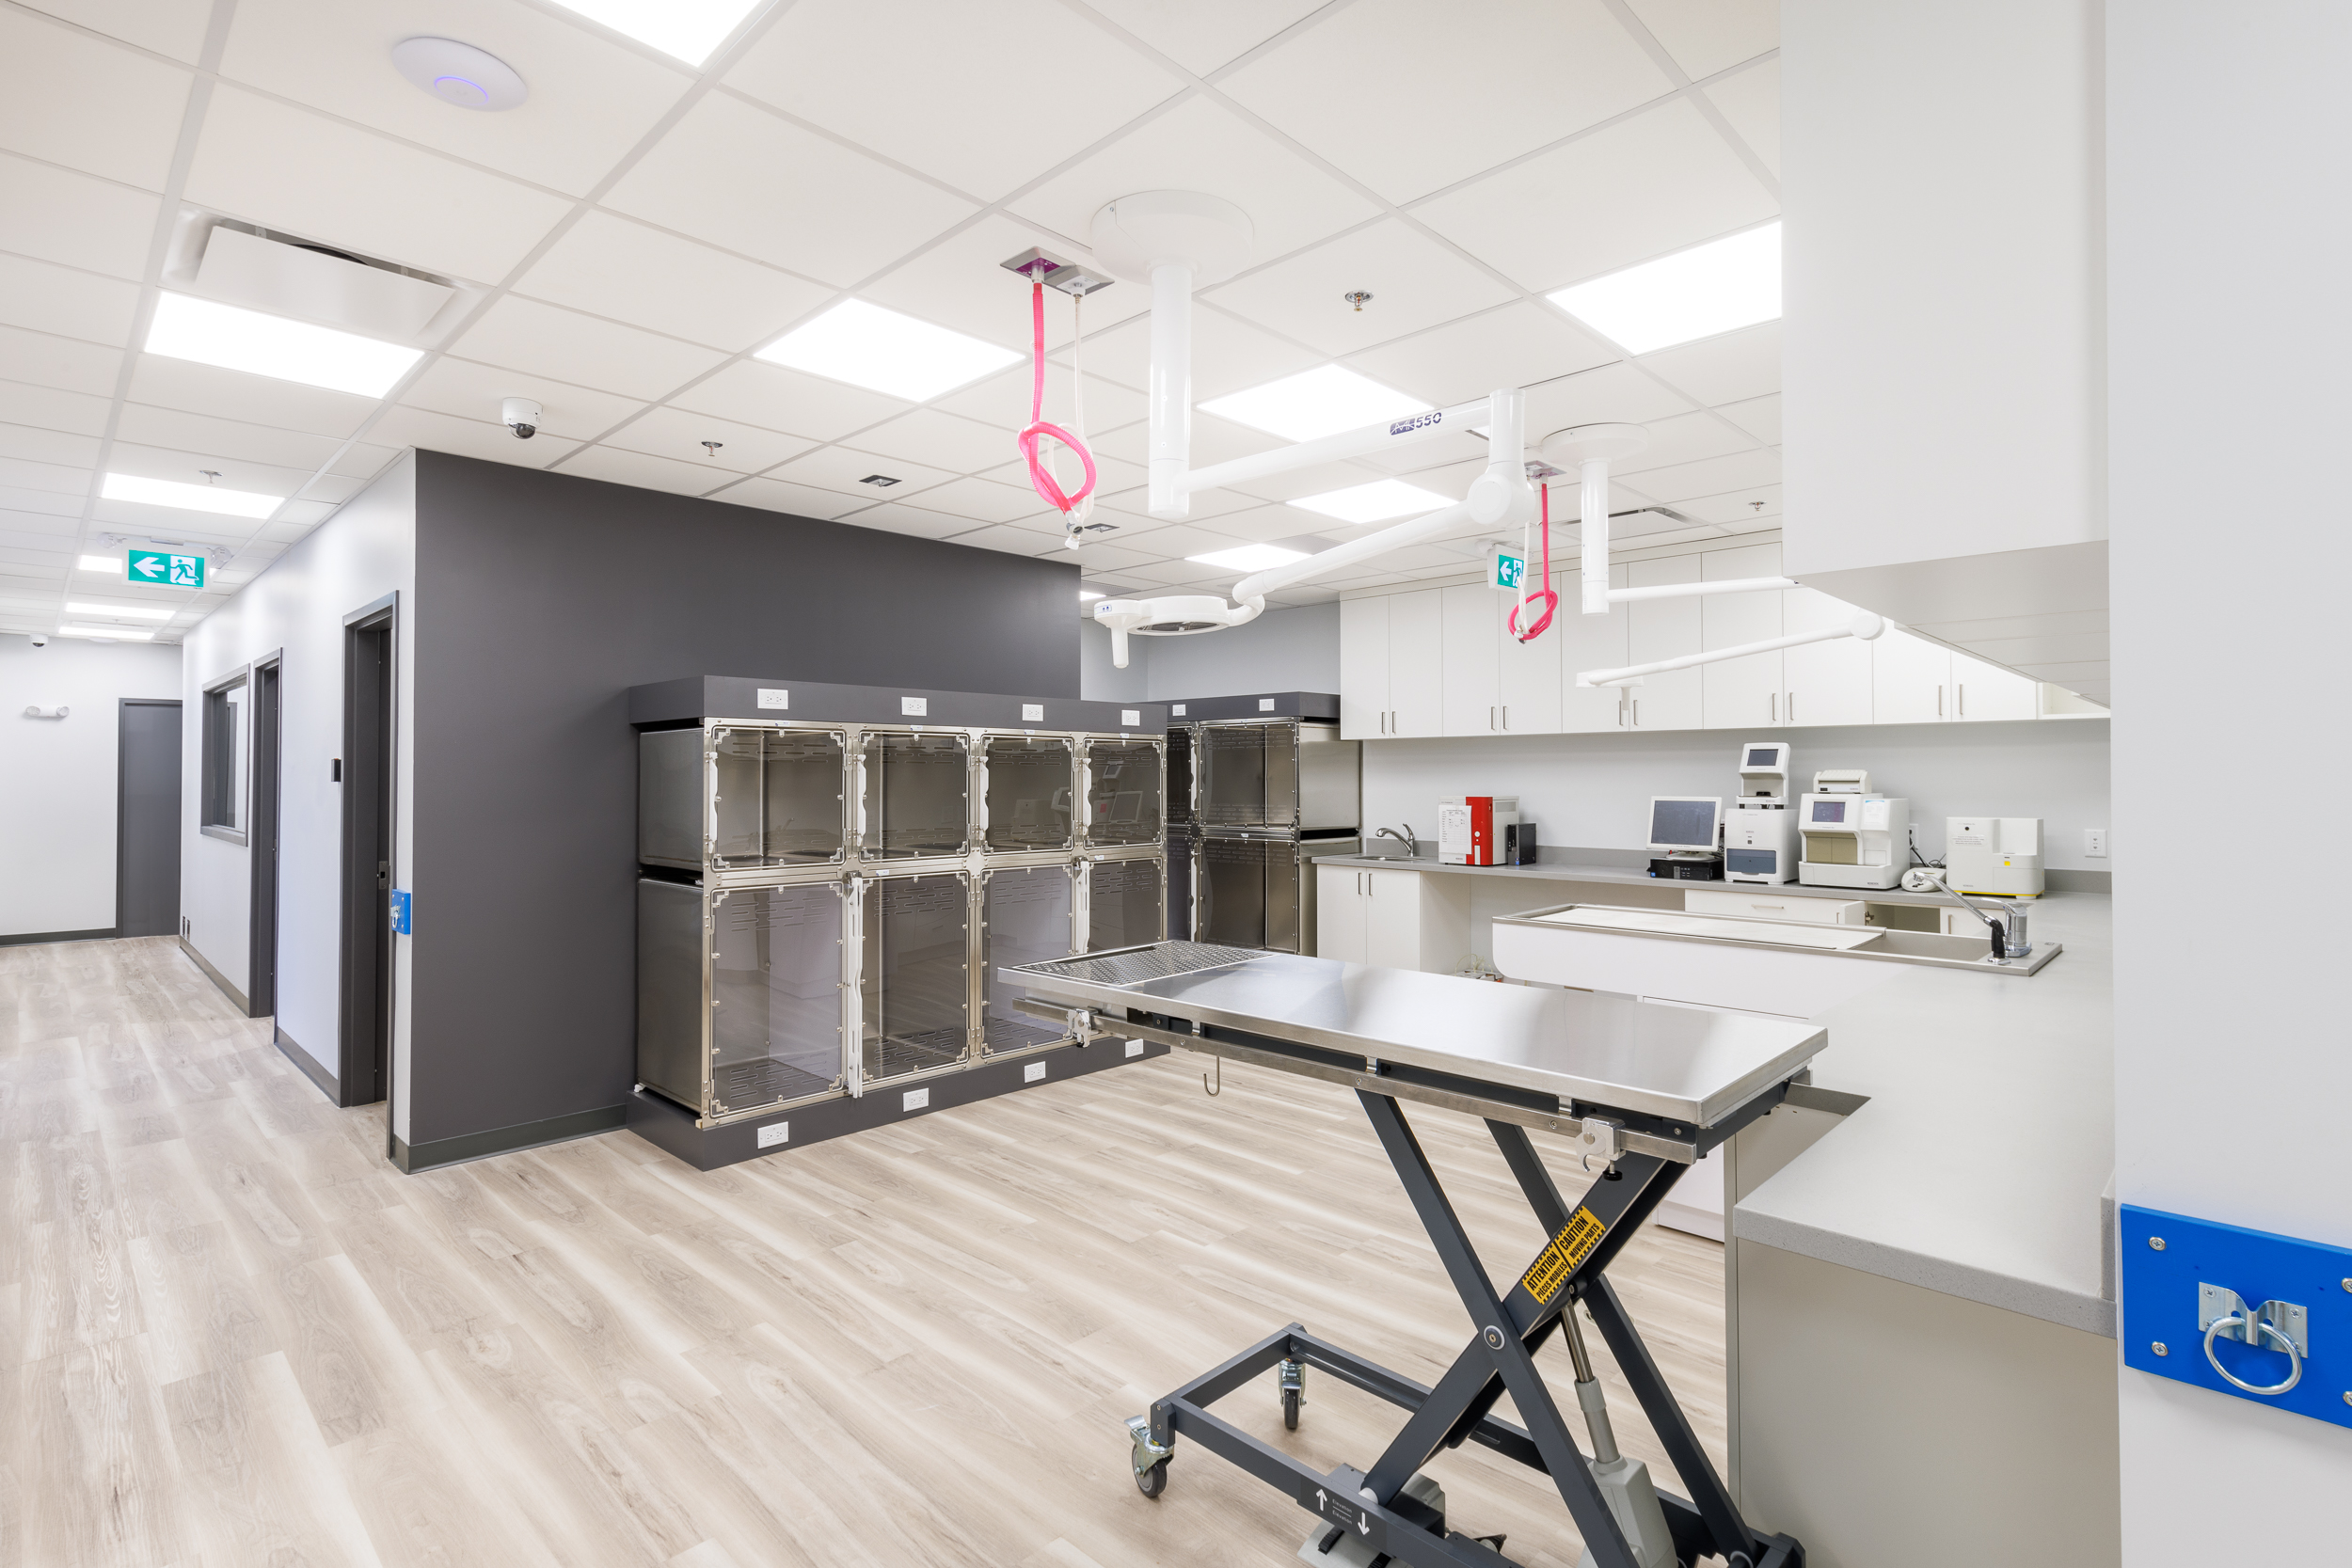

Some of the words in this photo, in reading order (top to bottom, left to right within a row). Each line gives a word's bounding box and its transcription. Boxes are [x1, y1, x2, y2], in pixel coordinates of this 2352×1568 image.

[1416, 412, 1441, 428] 550
[1559, 1215, 1589, 1250] CAUTION
[1568, 1237, 1587, 1259] MOVING
[1583, 1223, 1599, 1242] PARTS
[1527, 1250, 1560, 1291] ATTENTION
[1549, 1261, 1567, 1283] MOBILES
